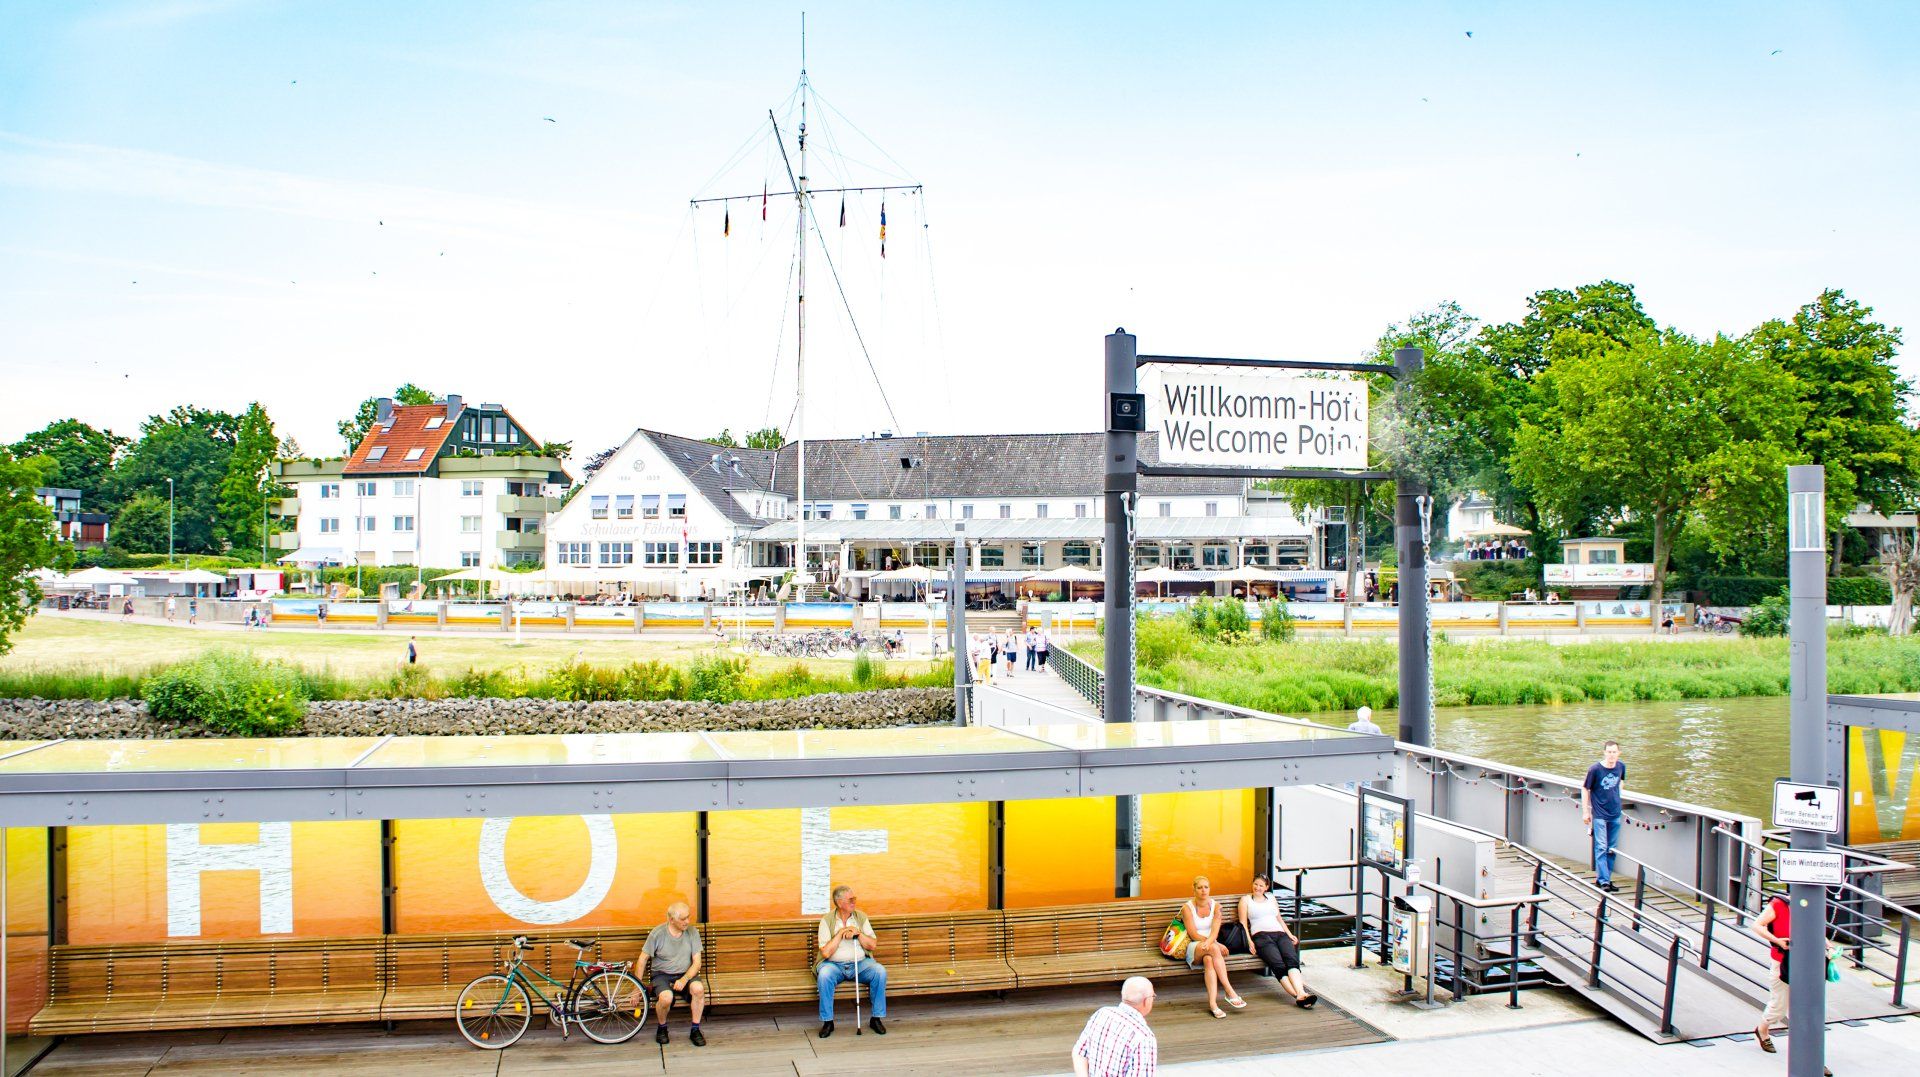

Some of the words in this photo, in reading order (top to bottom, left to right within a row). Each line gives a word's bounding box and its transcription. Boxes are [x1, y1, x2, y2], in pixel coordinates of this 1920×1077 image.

[1164, 420, 1288, 454] Welcome
[1298, 424, 1362, 456] Poin
[580, 522, 639, 536] Schulauer
[1798, 810, 1819, 819] Bereich
[1782, 858, 1797, 866] Kein
[1798, 858, 1840, 868] Winterdienst
